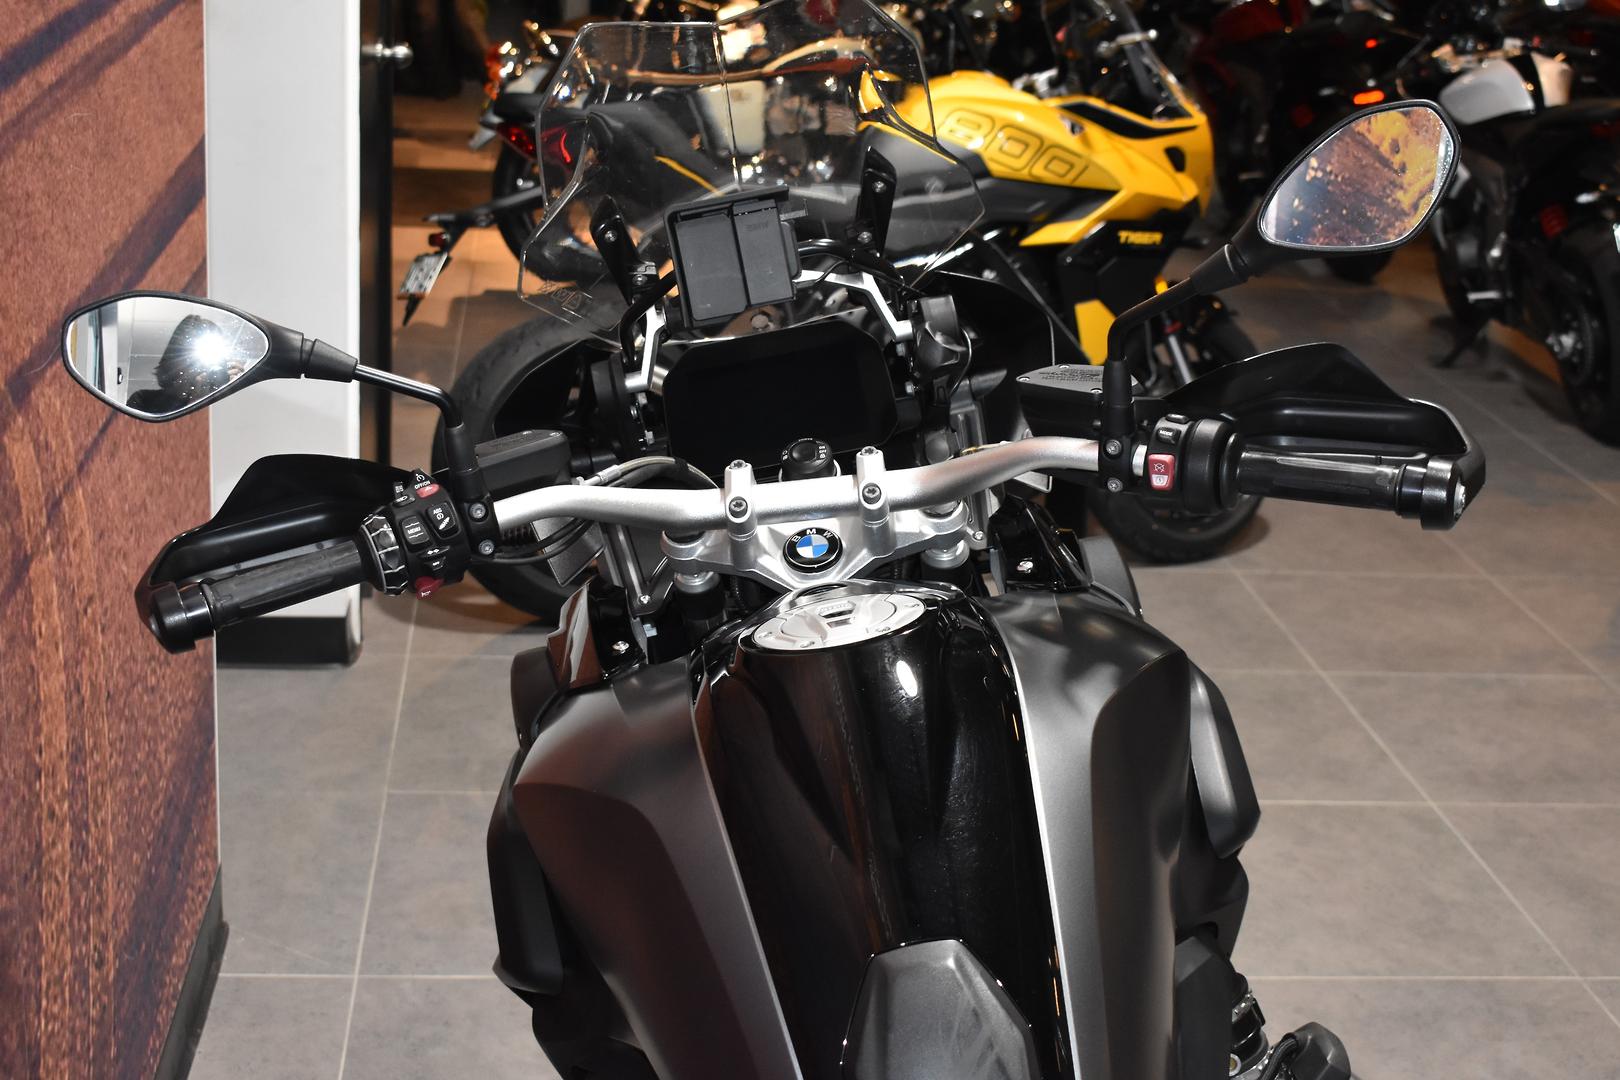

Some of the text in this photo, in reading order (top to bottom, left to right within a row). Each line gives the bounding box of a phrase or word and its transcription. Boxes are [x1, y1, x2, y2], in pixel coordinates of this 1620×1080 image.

[1118, 230, 1163, 245] TIGER
[433, 507, 442, 515] ABS
[407, 526, 421, 535] MENU
[791, 529, 833, 542] BMW
